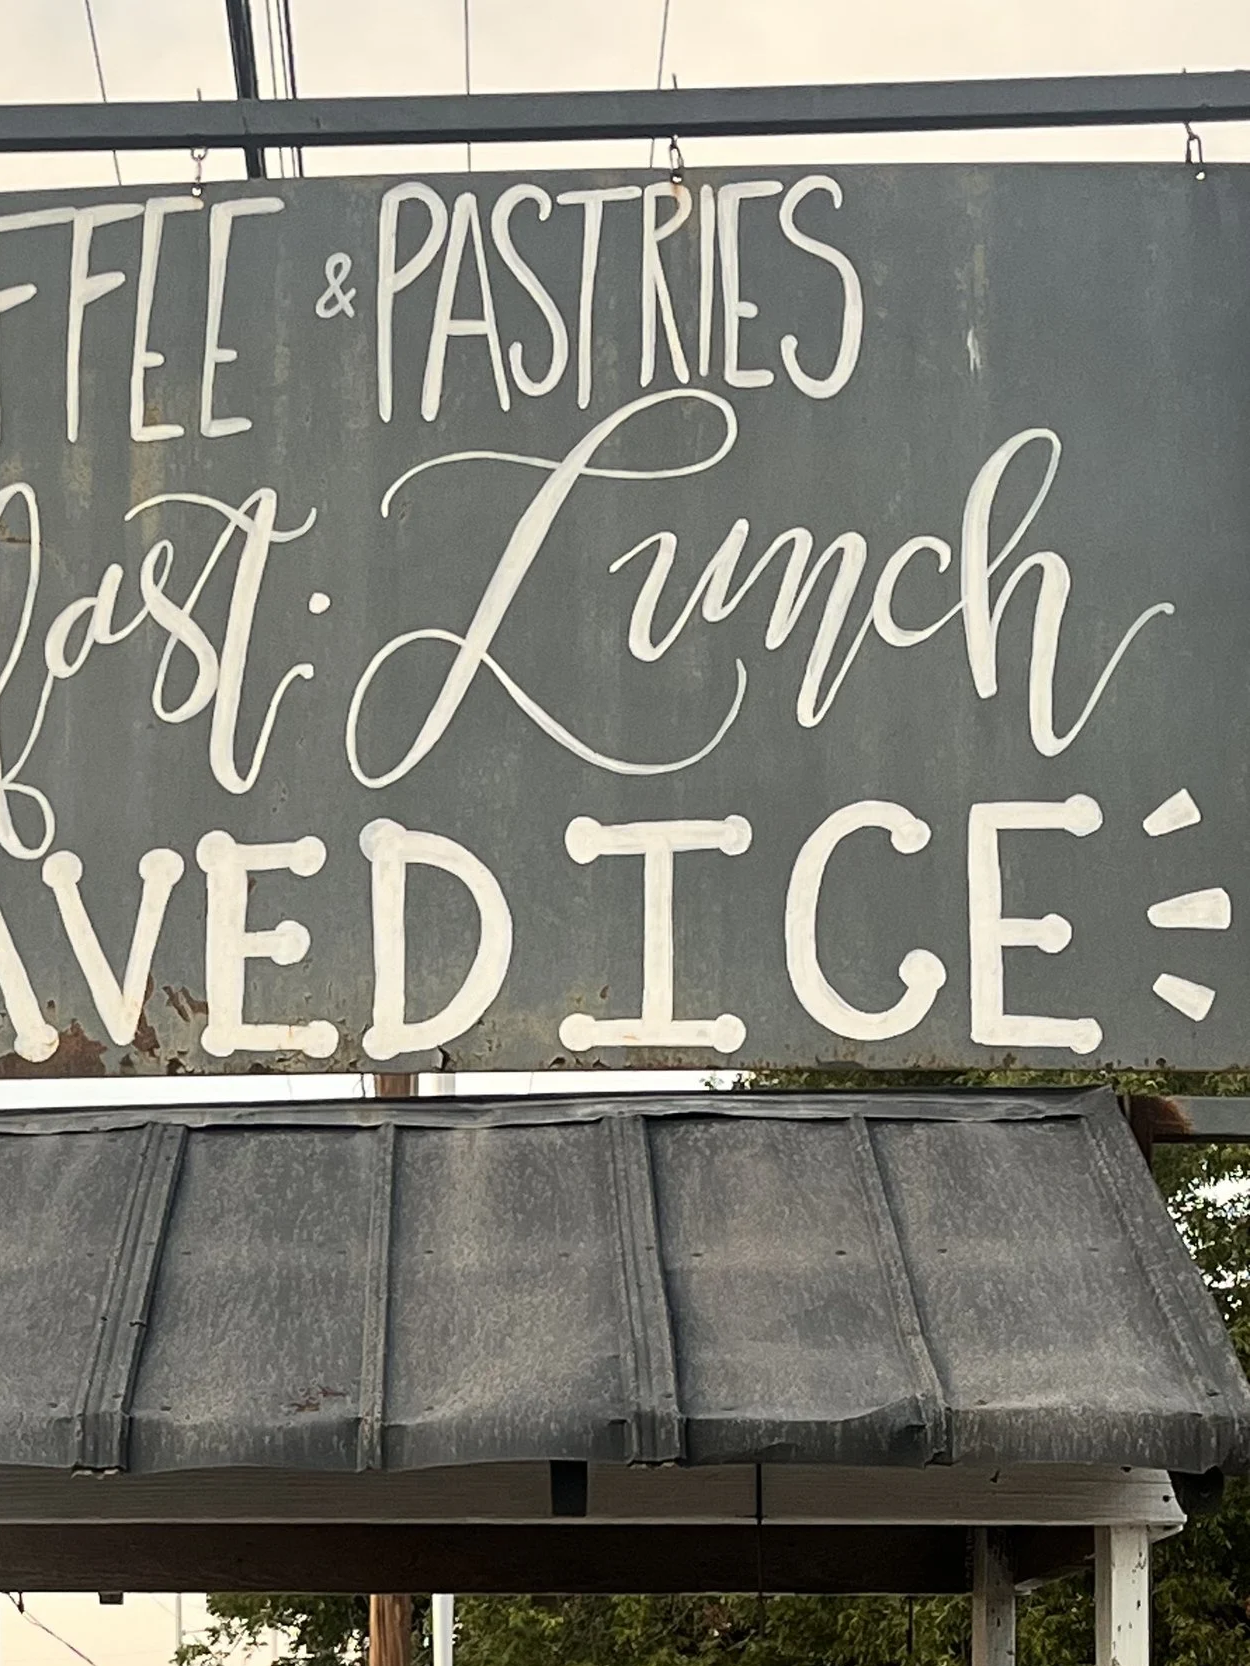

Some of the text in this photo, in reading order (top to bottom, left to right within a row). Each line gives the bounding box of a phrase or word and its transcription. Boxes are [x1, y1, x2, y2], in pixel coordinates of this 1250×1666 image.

[314, 251, 357, 319] &
[377, 173, 865, 423] PASTRIES
[345, 388, 1176, 789] Lunch
[558, 792, 1105, 1062] ICE
